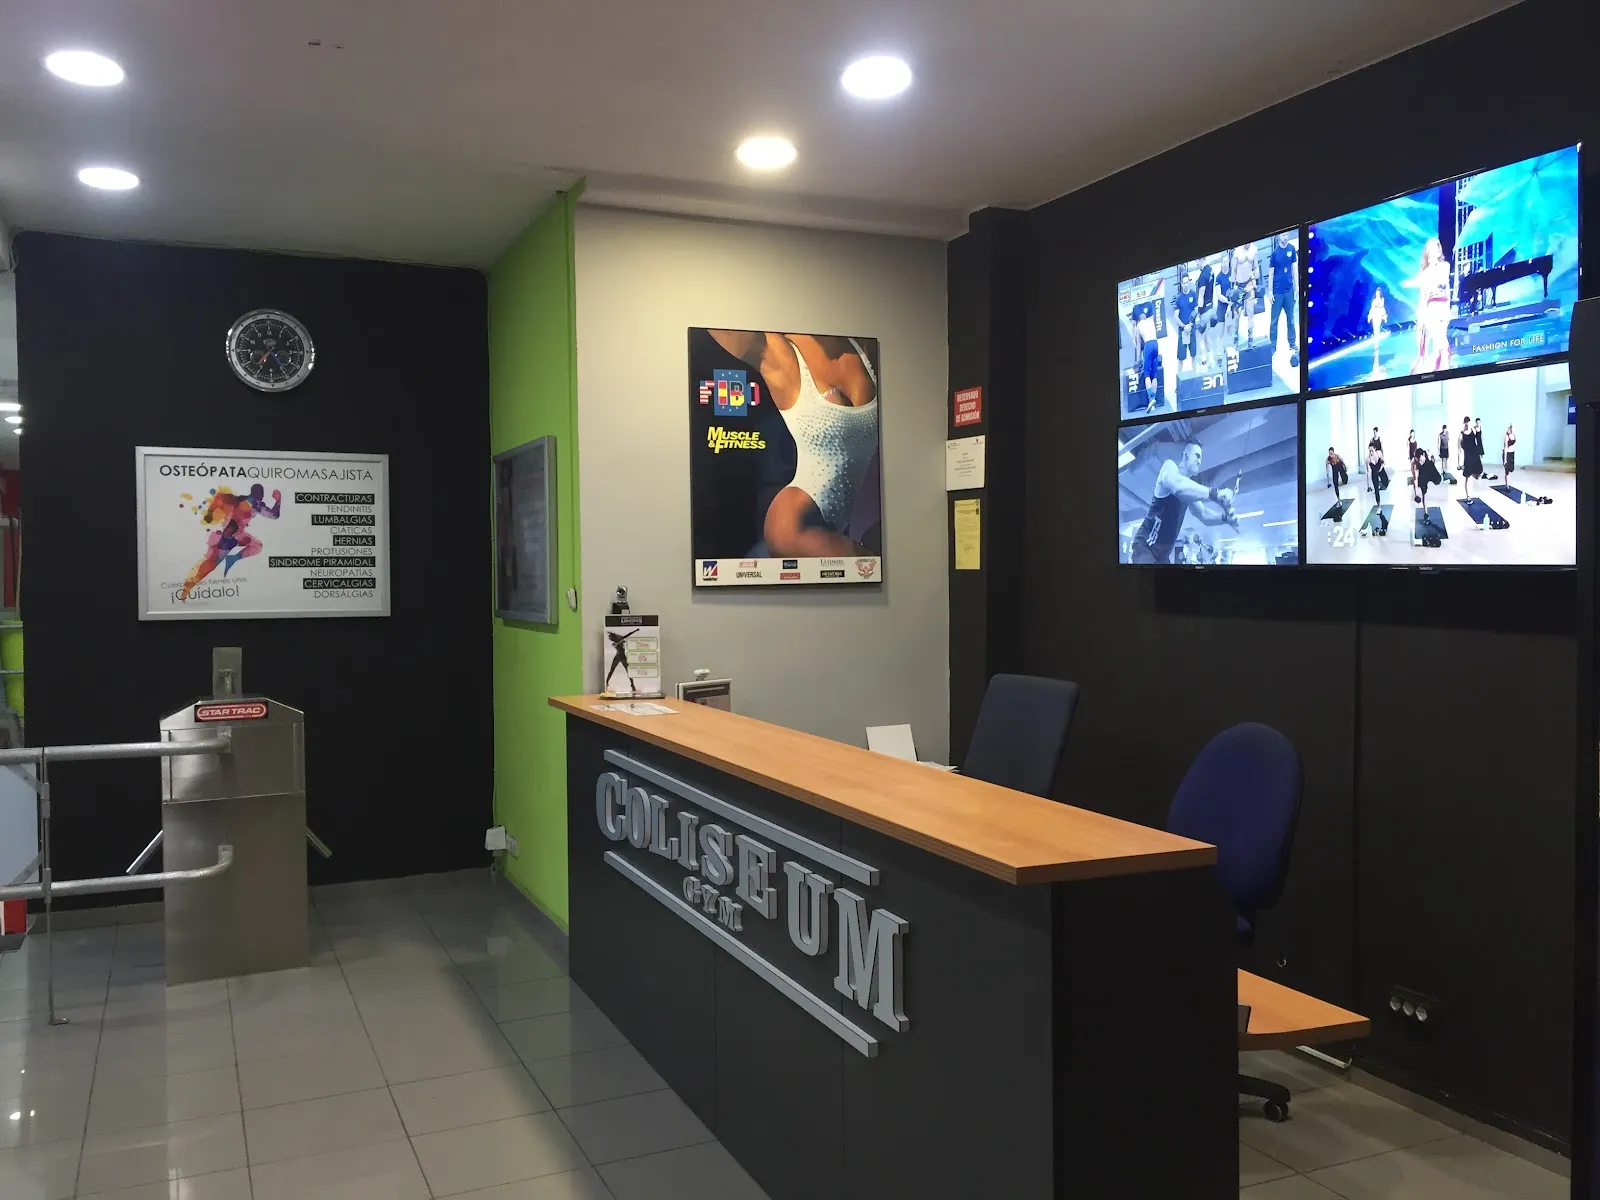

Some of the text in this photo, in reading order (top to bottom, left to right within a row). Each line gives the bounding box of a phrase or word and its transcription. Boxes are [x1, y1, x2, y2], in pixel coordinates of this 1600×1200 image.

[1472, 334, 1545, 353] FASHION FOR LIFE
[707, 426, 760, 441] MUSCLE
[296, 493, 372, 503] CONTRACTURAS
[327, 505, 372, 513] TENDINITIS
[313, 515, 373, 524] LUMBALGIAS
[334, 536, 373, 545] HERNIAS
[310, 547, 373, 556] PROTUSIONES
[270, 558, 373, 567] SINDROME PIRAMIDAL
[735, 571, 763, 579] UNIVERSAL
[304, 579, 373, 588] CERVICALGIAS
[231, 707, 261, 715] TRAC
[595, 771, 910, 1034] COLISEUM
[682, 875, 744, 932] GYM
